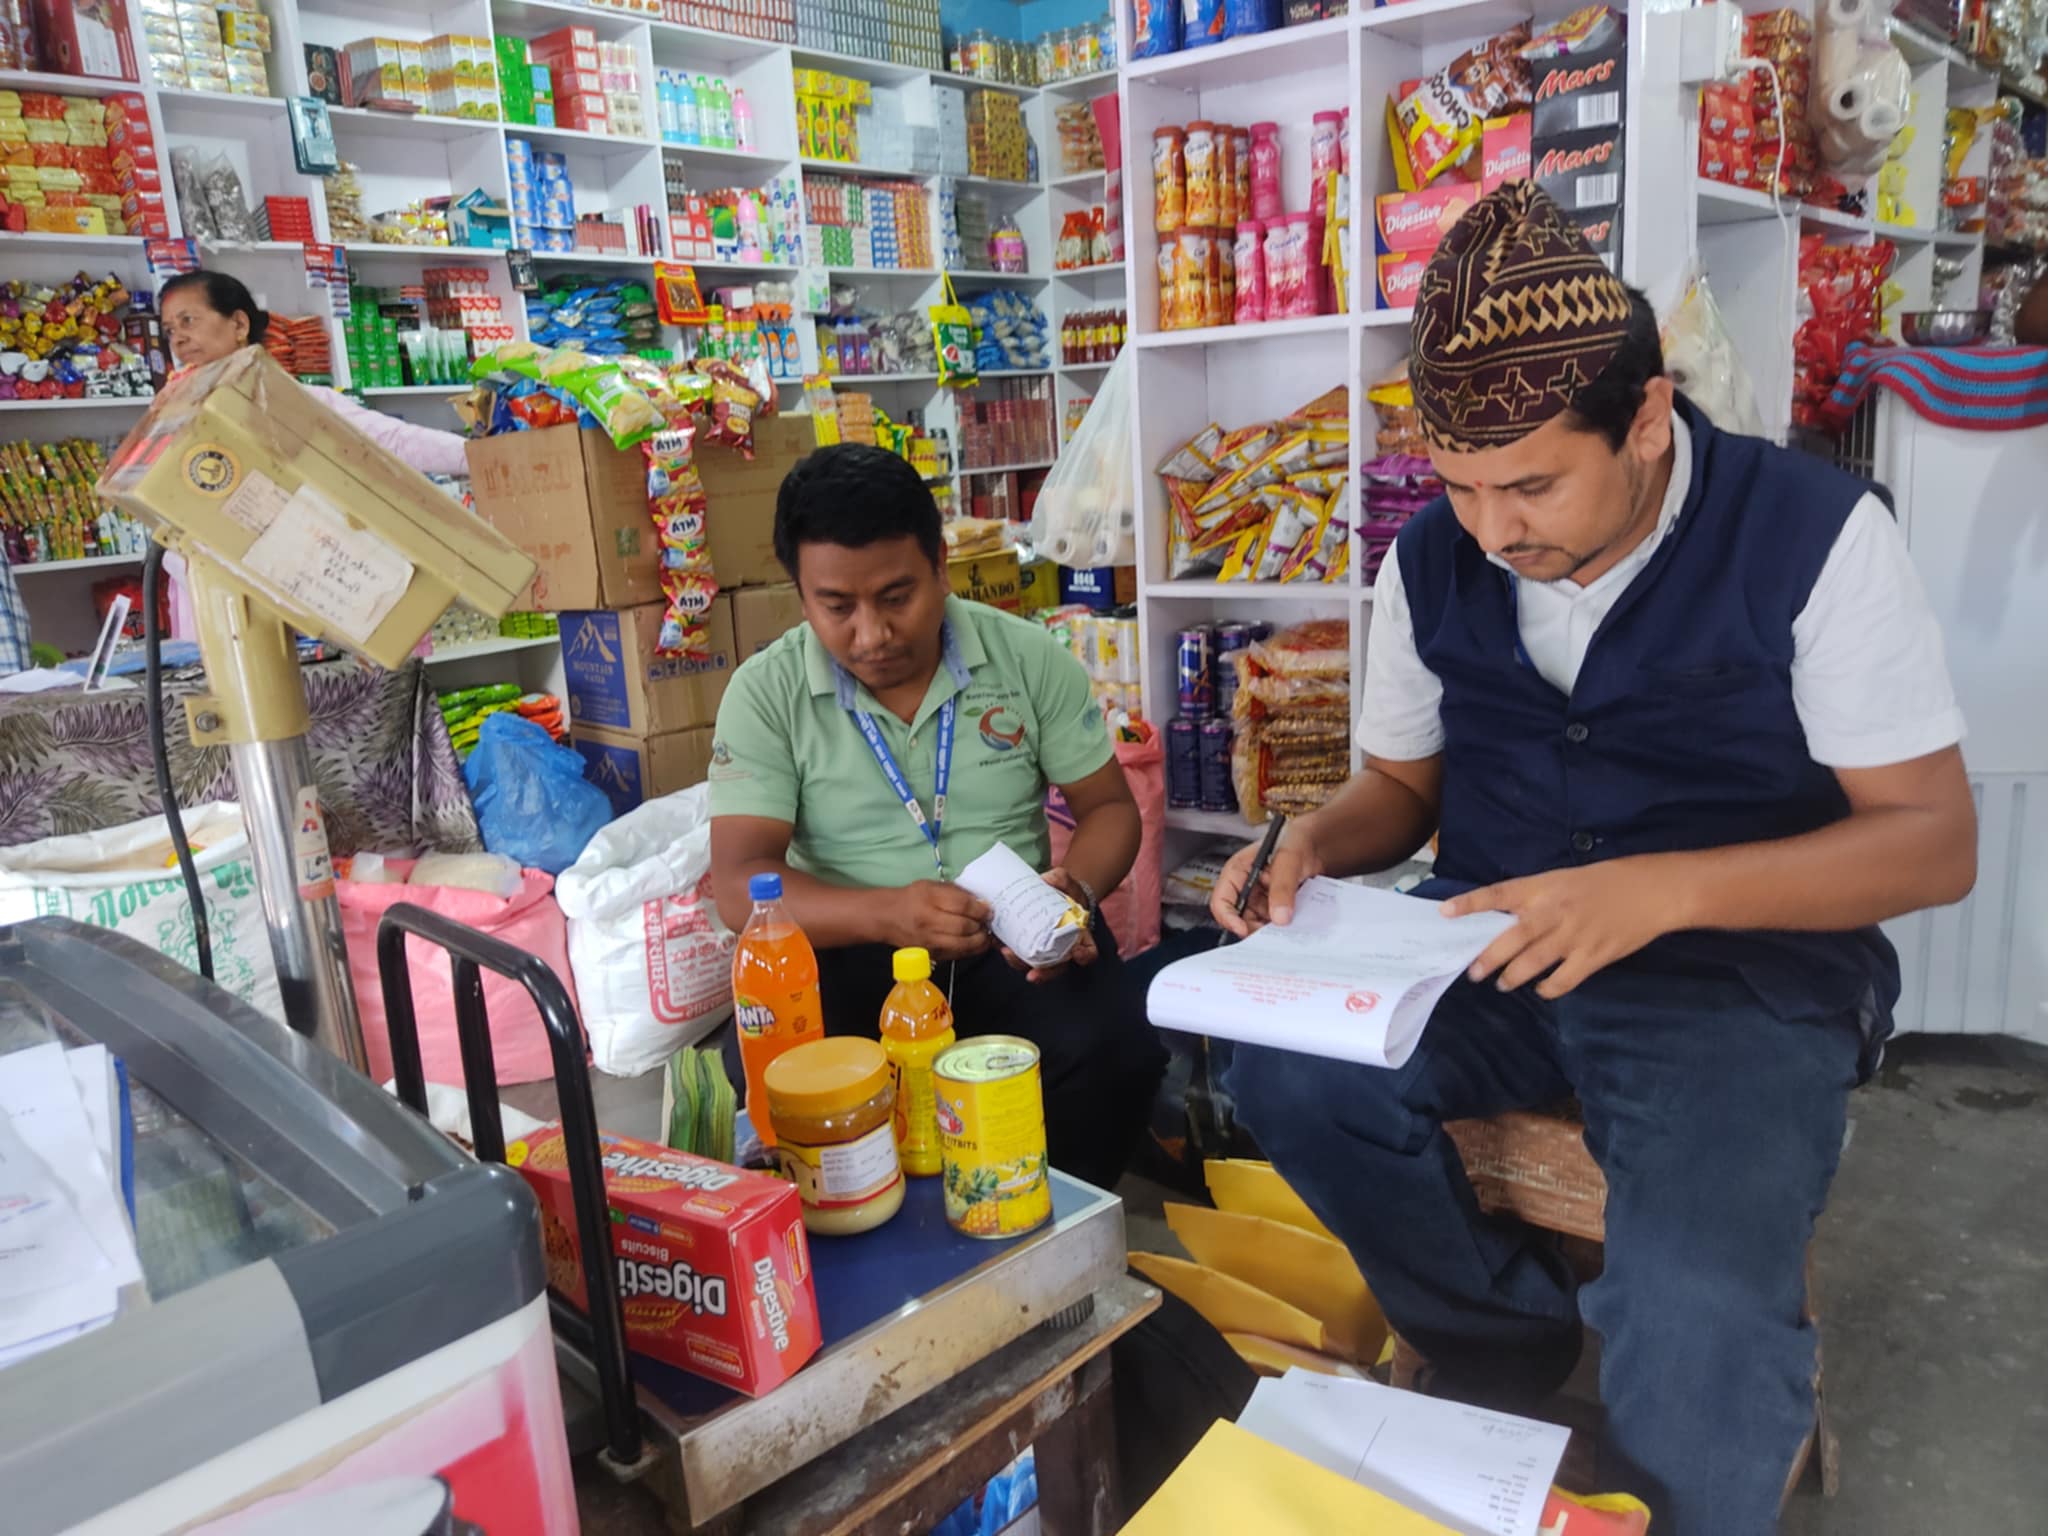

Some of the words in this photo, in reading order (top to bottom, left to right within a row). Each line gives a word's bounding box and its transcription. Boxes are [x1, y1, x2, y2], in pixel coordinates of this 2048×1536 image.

[1535, 58, 1616, 102] Mars
[1534, 140, 1614, 179] Mars
[1385, 204, 1442, 234] Digestive
[656, 438, 682, 452] ATM
[671, 520, 697, 534] ATM
[679, 595, 705, 609] ATM
[602, 1151, 741, 1192] Digestive
[620, 1238, 670, 1262] Biscuits
[617, 1258, 727, 1316] Digesti
[753, 1256, 791, 1352] Digestive
